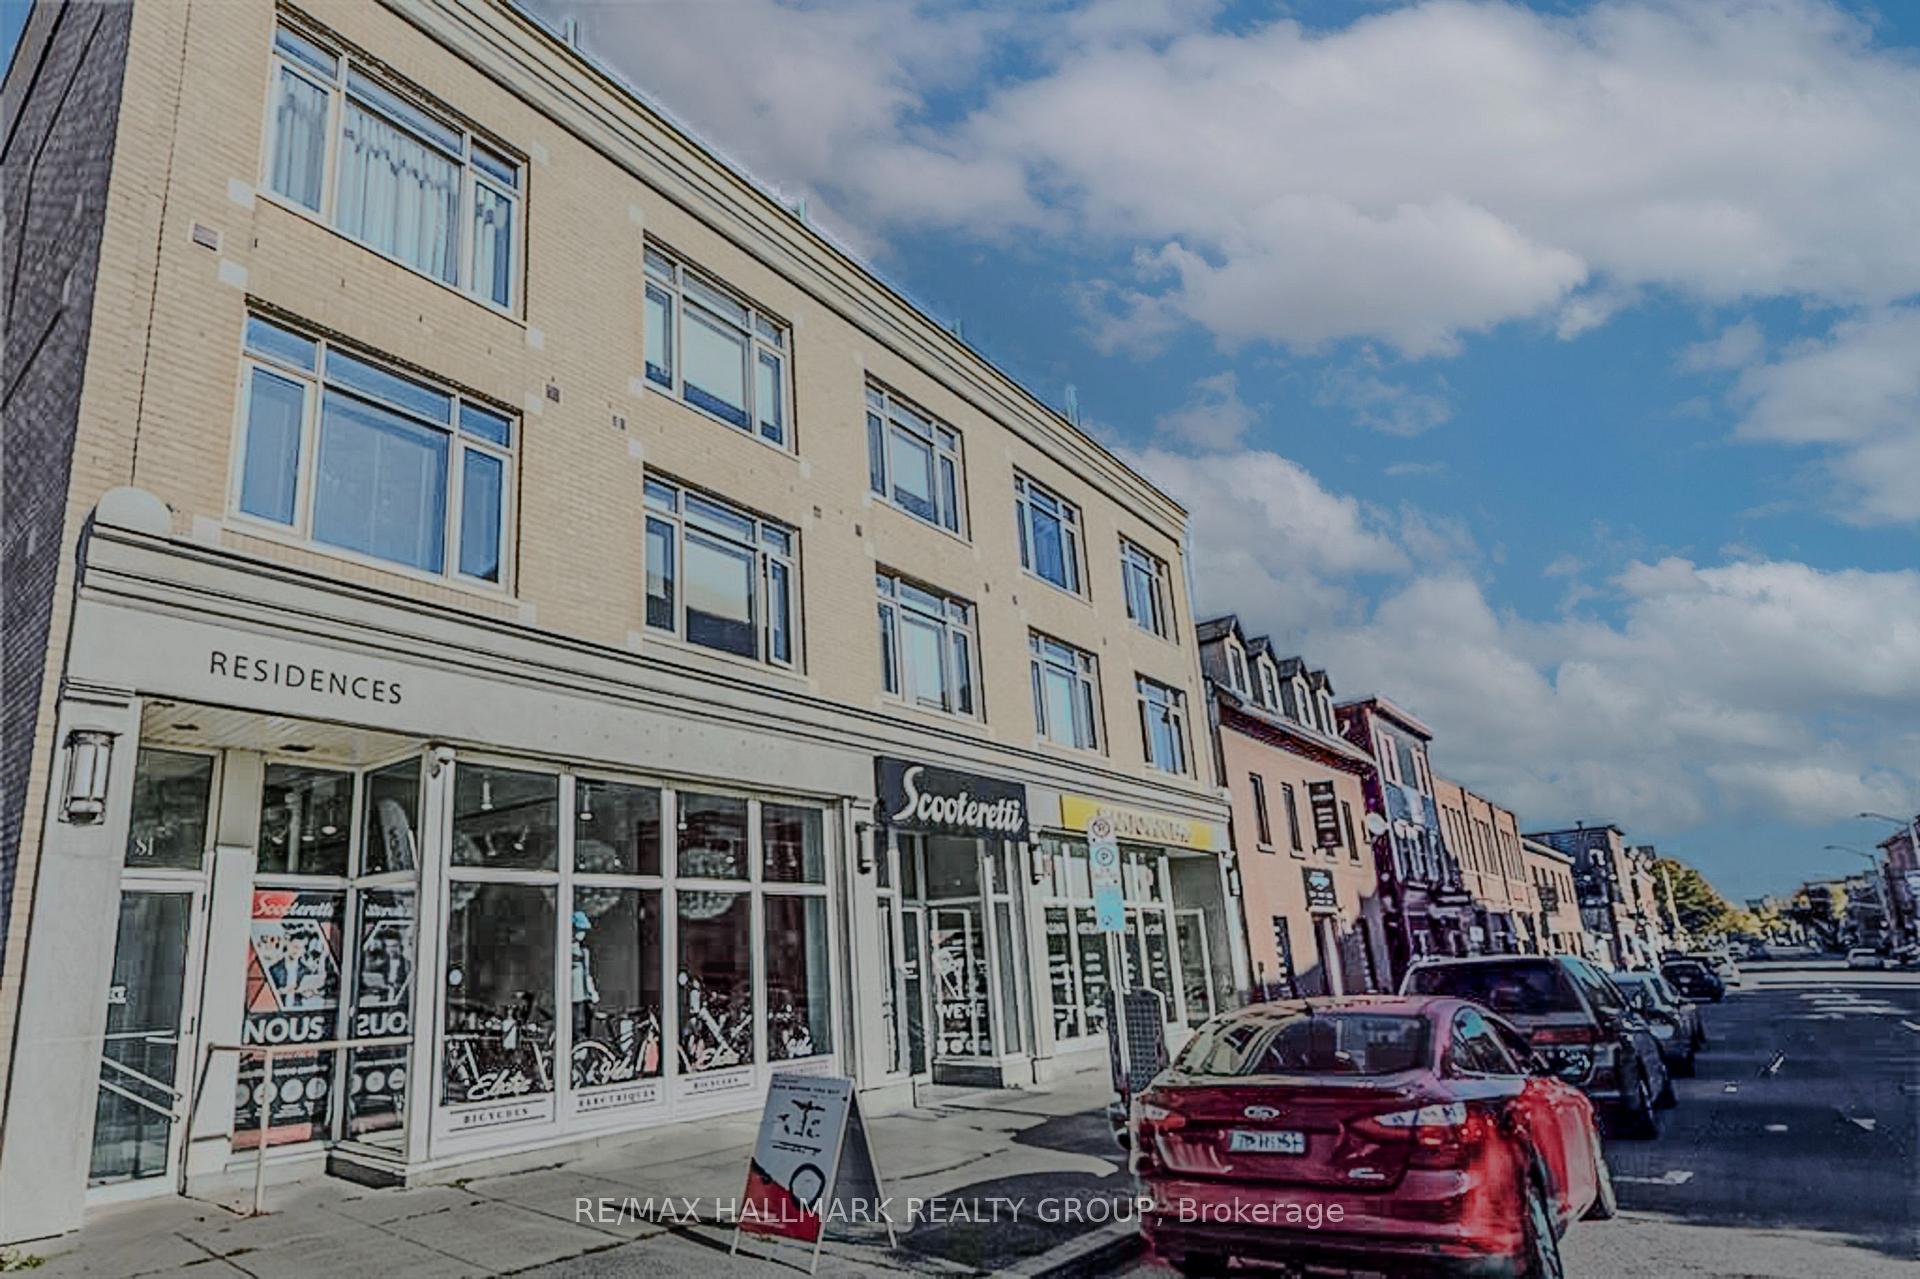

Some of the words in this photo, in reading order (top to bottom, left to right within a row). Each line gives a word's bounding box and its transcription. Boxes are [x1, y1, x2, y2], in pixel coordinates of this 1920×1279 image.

[210, 651, 402, 704] RESIDENCES
[892, 766, 1024, 833] Scooteretti
[243, 1015, 325, 1044] NOUS
